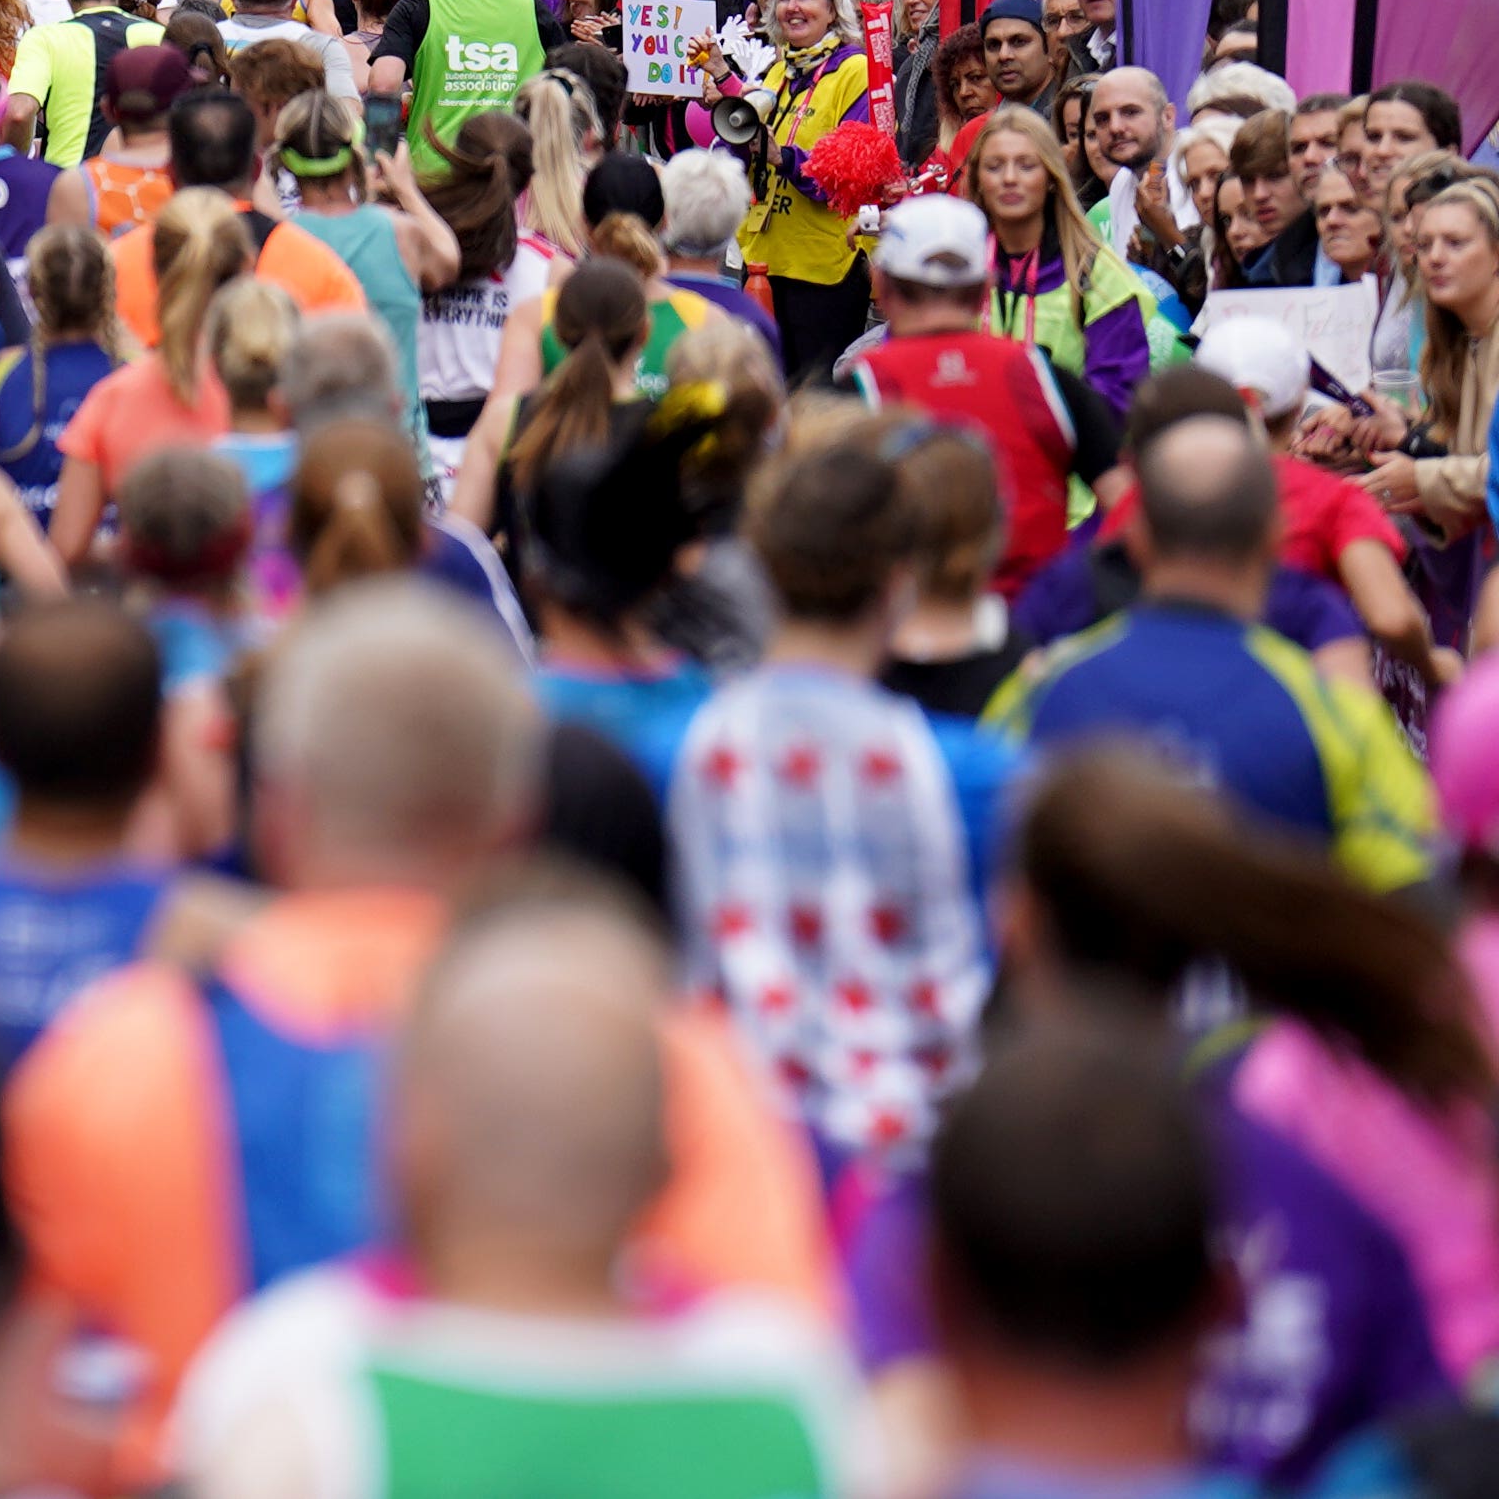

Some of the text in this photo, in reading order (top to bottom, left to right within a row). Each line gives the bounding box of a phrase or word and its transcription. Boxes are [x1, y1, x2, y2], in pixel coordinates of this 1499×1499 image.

[628, 4, 684, 30] YES!
[444, 35, 519, 72] tsa
[631, 32, 668, 56] YOU
[648, 62, 696, 85] DO IT
[444, 80, 517, 92] association
[423, 306, 506, 329] EVERYTHI
